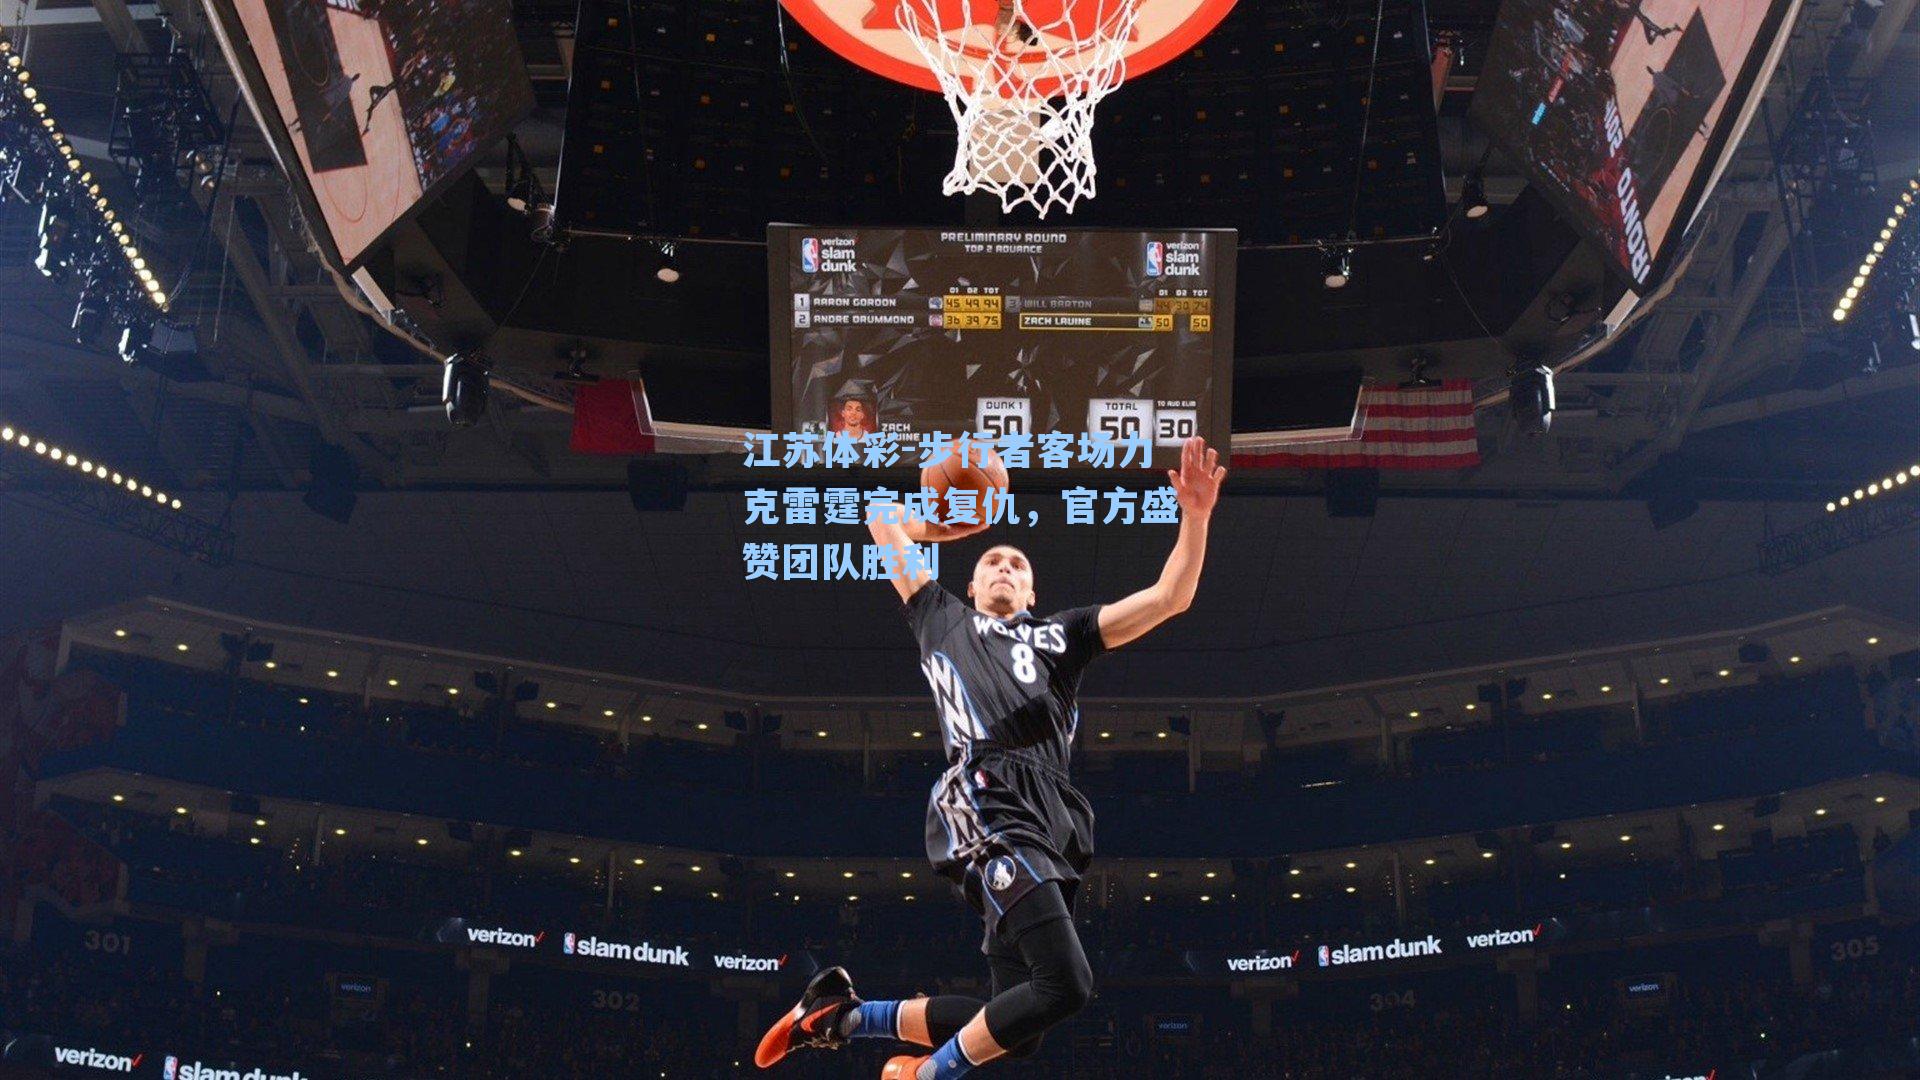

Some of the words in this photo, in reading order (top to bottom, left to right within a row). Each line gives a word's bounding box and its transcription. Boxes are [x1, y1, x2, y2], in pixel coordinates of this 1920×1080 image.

[821, 237, 856, 246] verizon
[941, 232, 1022, 242] PRELIMINARY
[1025, 233, 1067, 243] ROUND
[821, 246, 856, 260] slam
[965, 244, 984, 253] TOP
[986, 245, 993, 253] 2
[1165, 241, 1200, 250] verizon
[1165, 250, 1200, 263] slam
[821, 259, 858, 272] dunk
[1165, 263, 1201, 276] dunk
[813, 298, 850, 307] AARON
[853, 298, 897, 307] GORDON
[946, 299, 960, 308] 45
[965, 299, 980, 308] 49
[984, 299, 999, 308] 94
[799, 314, 806, 324] 2
[813, 315, 850, 324] ANDRE
[853, 315, 915, 324] DRUMMOND
[966, 316, 980, 325] 39
[984, 316, 999, 325] 75
[1024, 316, 1052, 325] ZACH
[1156, 318, 1170, 327] 50
[1193, 318, 1208, 327] 50
[986, 402, 1015, 410] DUNK
[1106, 402, 1138, 411] TOTAL
[881, 422, 911, 432] ZACH
[983, 415, 1023, 440] 50
[1100, 416, 1141, 441] 50
[1159, 418, 1193, 439] 30
[1011, 642, 1037, 684] 8
[85, 930, 131, 954] 301
[467, 927, 536, 948] verizon
[1466, 929, 1534, 948] verizon
[576, 936, 632, 960] slam
[633, 942, 690, 966] dunk
[1331, 944, 1384, 965] slam
[1386, 935, 1443, 959] dunk
[1831, 935, 1880, 962] 305
[714, 954, 779, 971] verizon
[1227, 954, 1292, 972] verizon
[592, 989, 641, 1011] 302
[54, 1046, 132, 1072] verizon
